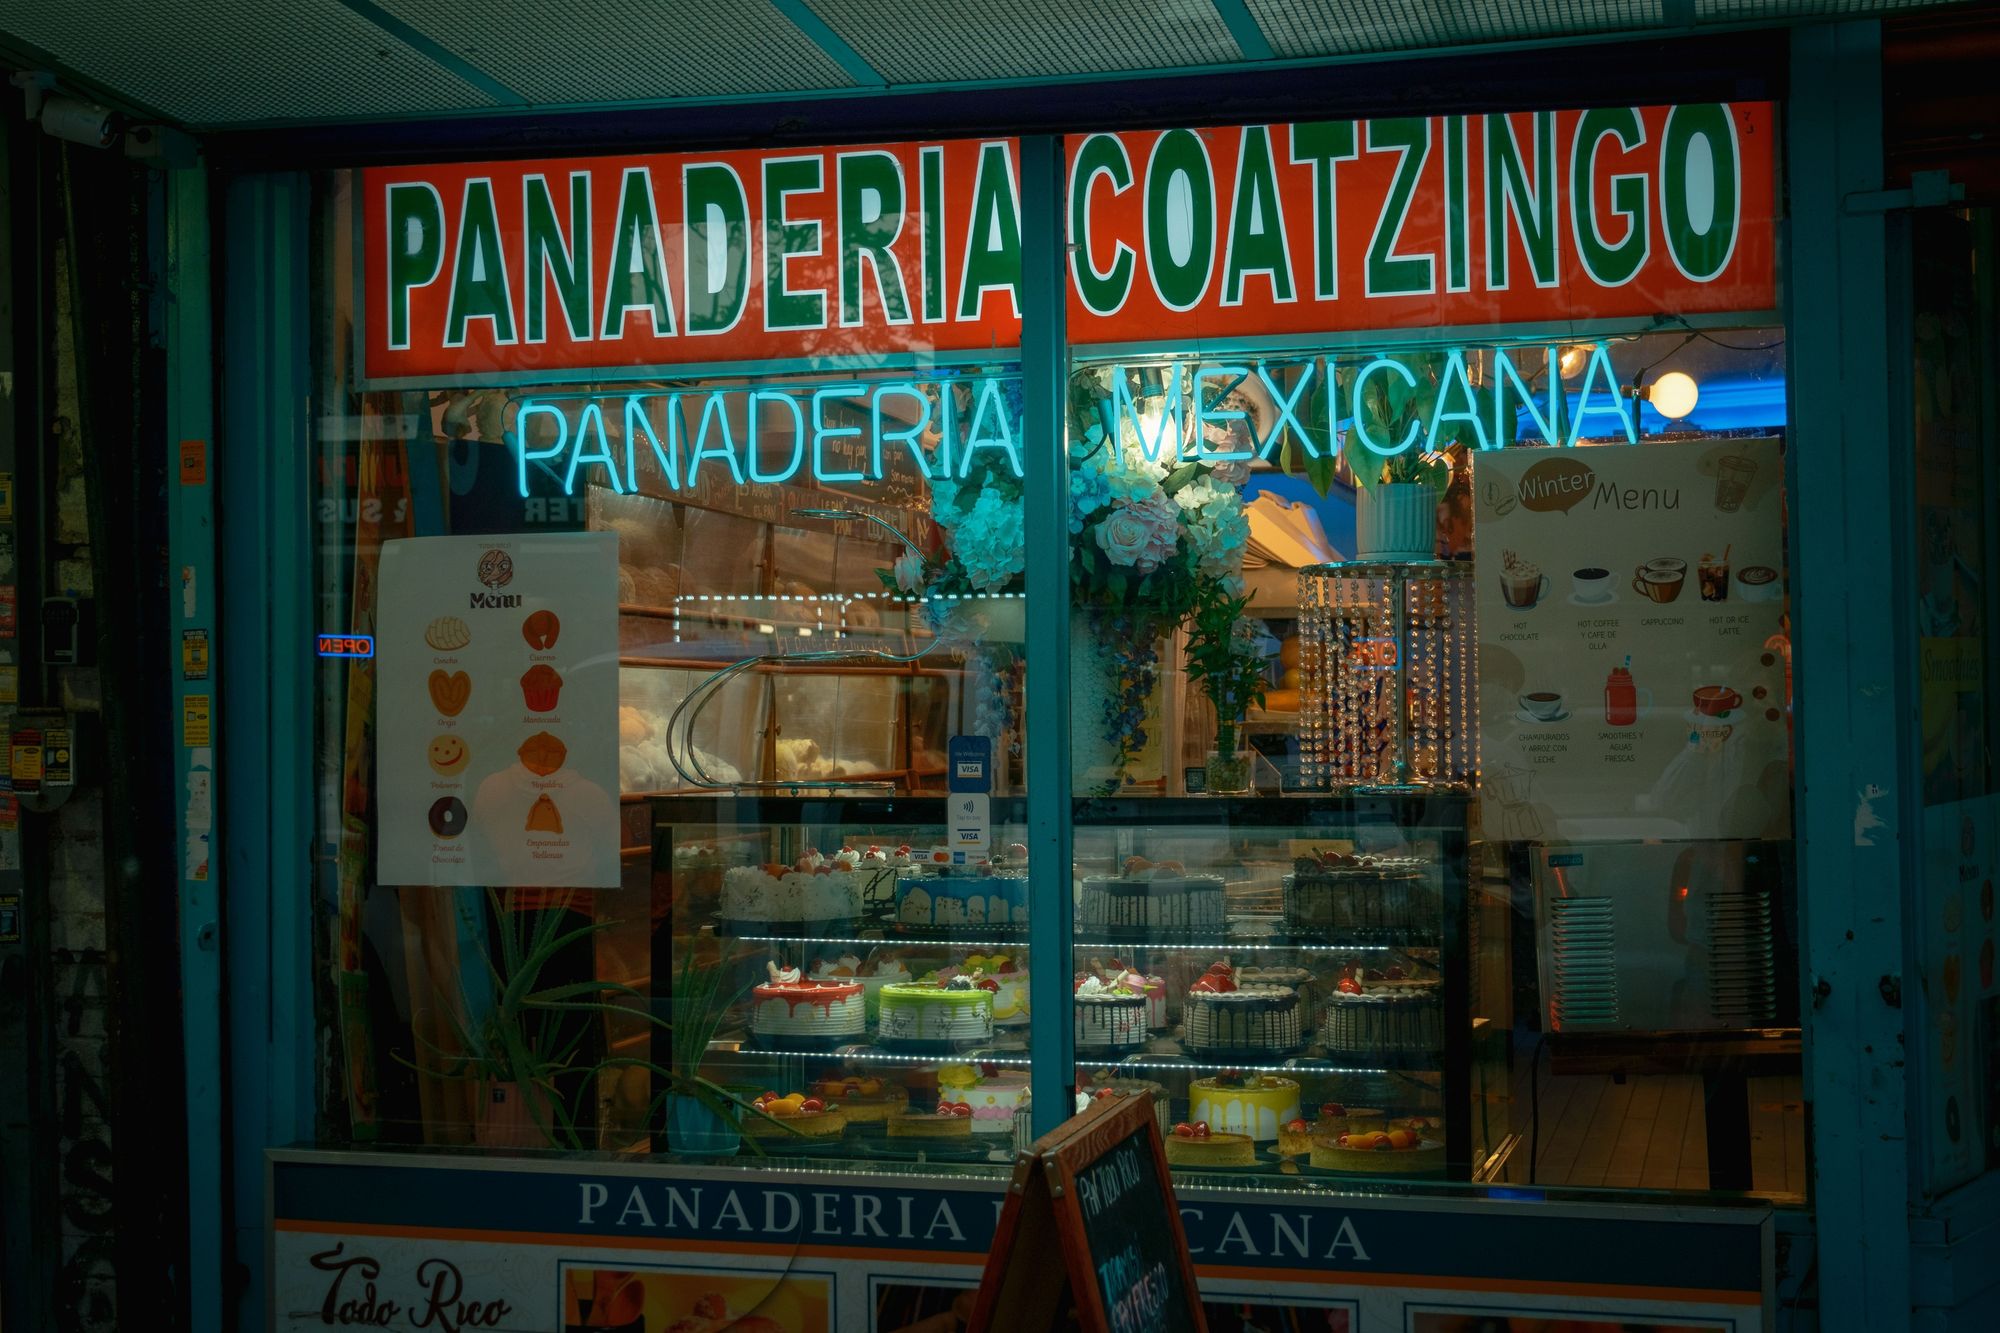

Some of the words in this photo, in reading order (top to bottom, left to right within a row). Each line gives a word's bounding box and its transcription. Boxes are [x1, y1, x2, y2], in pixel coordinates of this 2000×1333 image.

[385, 140, 1022, 351] PANADERIA
[1069, 103, 1741, 317] COATZINGO
[516, 377, 1024, 498] PANADERIA
[1111, 346, 1640, 465] MEXICANA
[1517, 470, 1596, 503] Winter
[1593, 482, 1680, 511] Menu
[469, 592, 523, 610] Menu
[1577, 619, 1591, 629] HOT
[1593, 618, 1620, 628] COFFEE
[1640, 616, 1685, 626] CAPPUCCINO
[1709, 616, 1724, 624] HOT
[1725, 616, 1736, 624] OR
[1737, 616, 1750, 624] ICE
[1513, 622, 1527, 630] HOT
[1718, 626, 1741, 636] LATTE
[1499, 632, 1539, 641] CHOCOLATE
[1607, 630, 1617, 638] DE
[1588, 641, 1607, 650] OLLA
[1528, 744, 1549, 753] ARROZ
[1552, 743, 1568, 752] CON
[1609, 742, 1633, 751] AGUAS
[961, 765, 979, 773] VISA
[961, 832, 979, 840] VISA
[914, 853, 928, 861] VISA
[579, 1181, 968, 1242] PANADERIA
[311, 1242, 401, 1327] Todo
[409, 1258, 512, 1332] Rico
